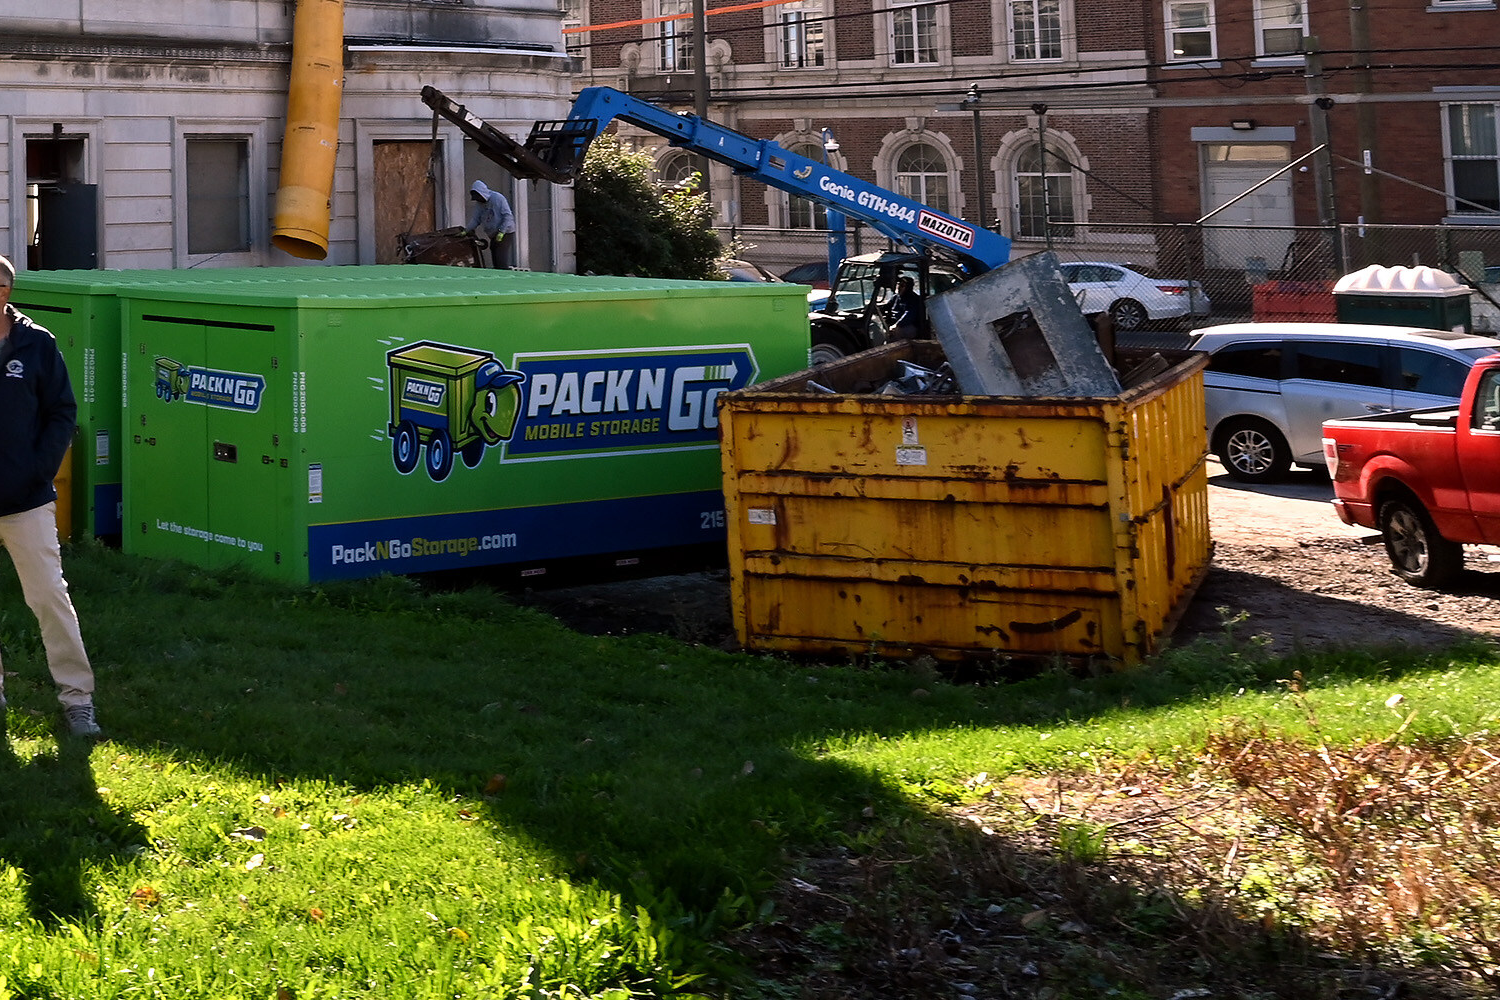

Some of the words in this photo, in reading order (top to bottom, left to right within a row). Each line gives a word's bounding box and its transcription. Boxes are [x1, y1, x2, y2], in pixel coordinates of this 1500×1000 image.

[819, 175, 855, 201] Genie
[857, 191, 916, 224] GTH-844
[920, 215, 971, 244] MAZZOTTA
[191, 373, 223, 393] PACK
[224, 378, 234, 394] N
[406, 381, 424, 395] PACK
[526, 369, 634, 418] PACK
[636, 367, 666, 411] N
[524, 422, 586, 442] MOBILE
[590, 417, 661, 437] STORAGE
[700, 510, 724, 529] 215
[156, 518, 169, 531] Let
[169, 521, 182, 534] the
[183, 526, 213, 542] storage
[214, 533, 236, 546] come
[237, 537, 246, 548] to
[247, 540, 264, 552] you
[331, 532, 517, 565] PackNGoStorage.com
